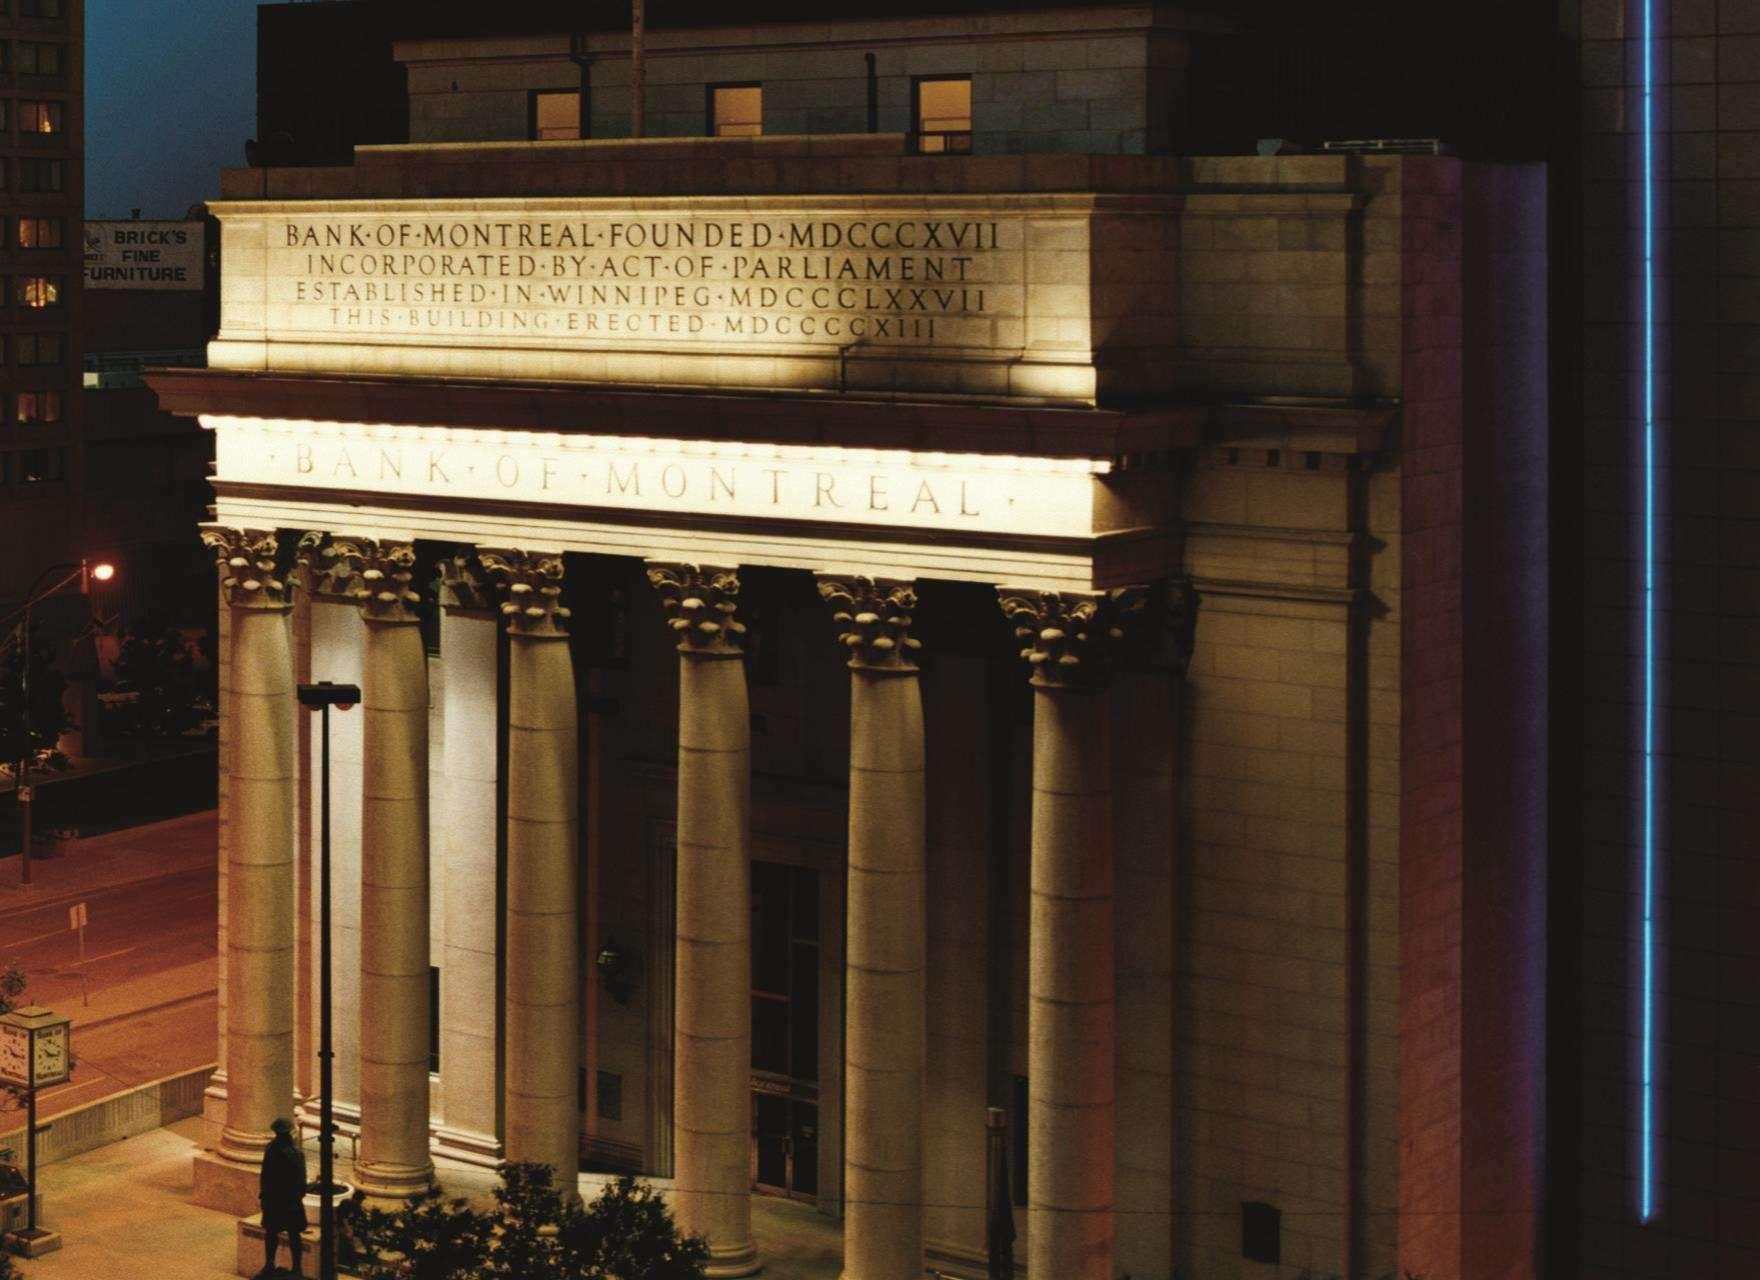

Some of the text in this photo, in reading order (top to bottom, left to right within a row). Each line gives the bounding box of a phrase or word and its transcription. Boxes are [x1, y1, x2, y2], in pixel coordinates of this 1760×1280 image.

[114, 230, 187, 245] BRICK'S
[286, 222, 999, 249] BANK OF MONTREAL FOUNDED MDCCCXVII
[121, 250, 161, 263] FINE
[307, 253, 973, 281] INCORPORATED BY ACT OF PARLIAMENT
[296, 281, 986, 312] ESTABLISHED IN WINNIPEG MDCCCLXXVII
[329, 307, 935, 338] THIS BUILDING ERECTED MDCCCCXIII
[296, 443, 980, 517] BANK OF MONTREAL
